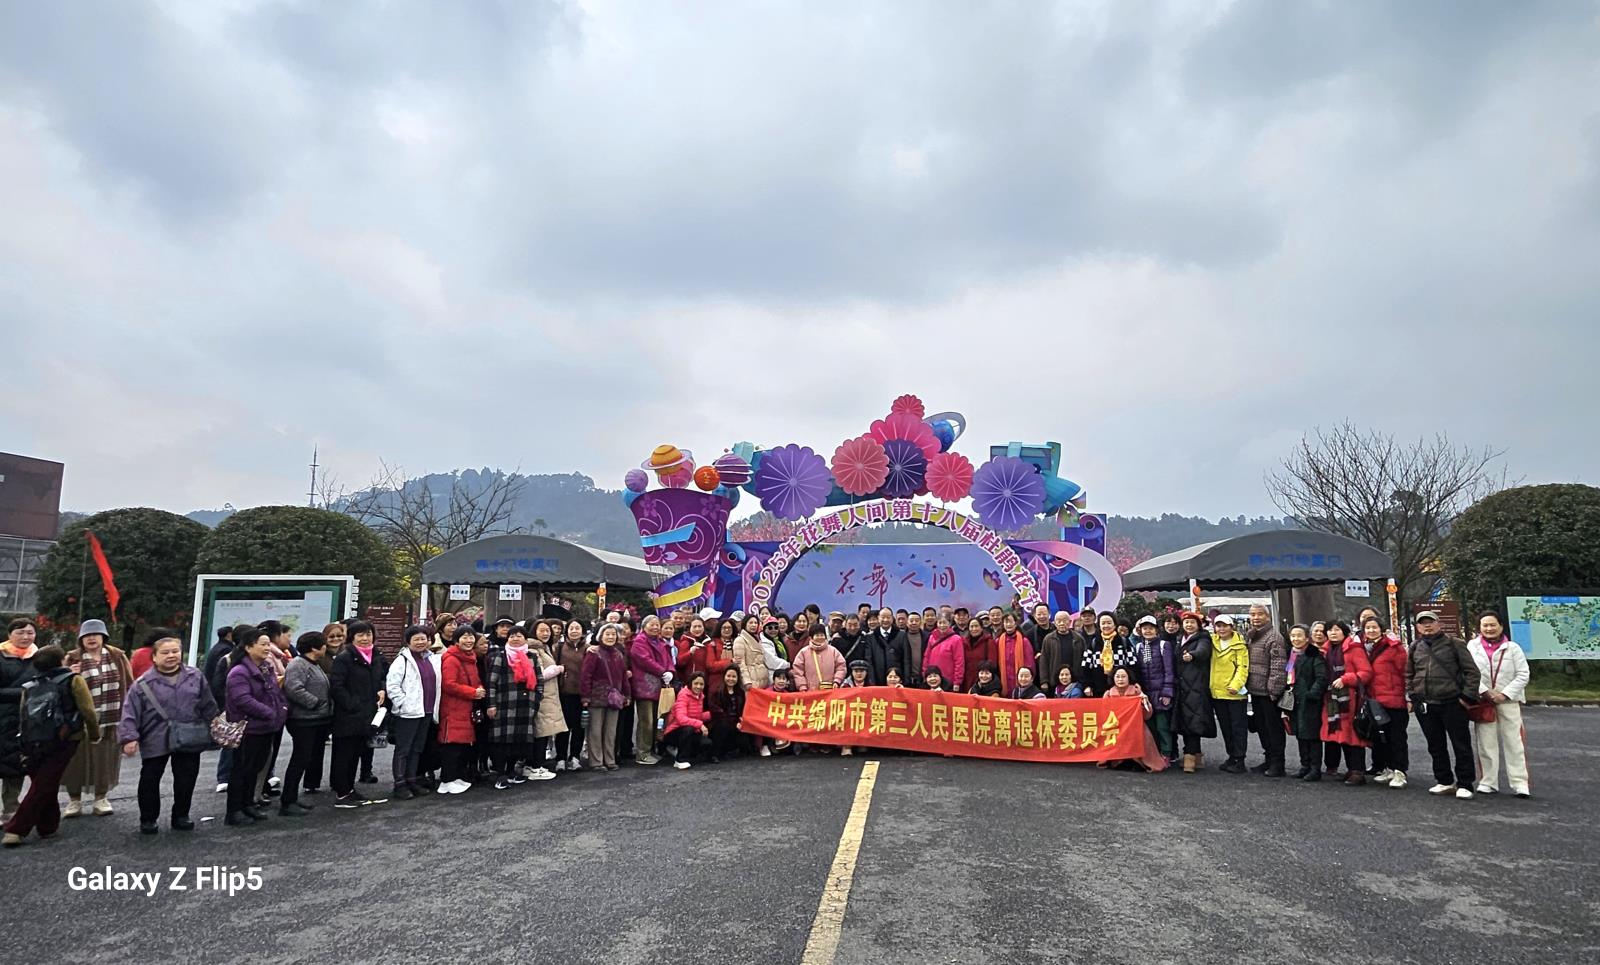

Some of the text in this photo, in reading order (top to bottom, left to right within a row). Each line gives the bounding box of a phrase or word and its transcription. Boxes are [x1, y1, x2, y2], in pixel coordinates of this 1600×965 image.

[836, 562, 956, 609] 花舞人间
[767, 695, 1120, 750] 中共绵阳市第三人民医院离退休委员会
